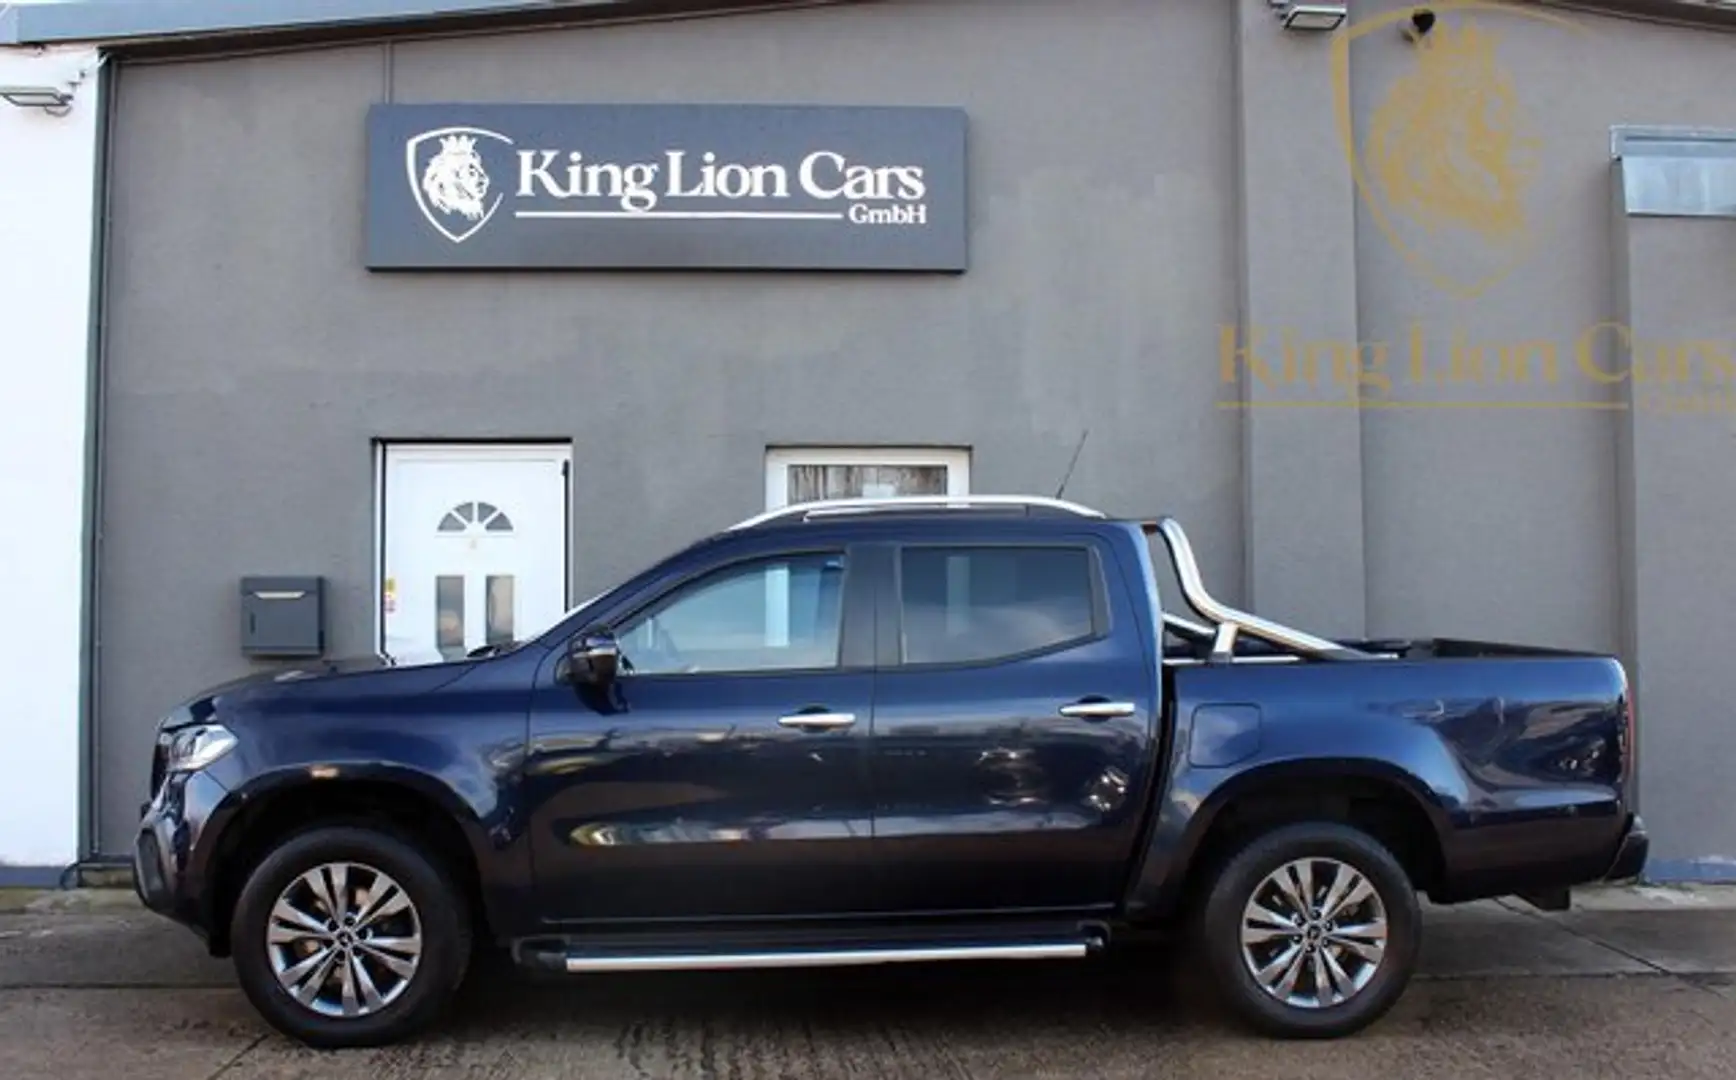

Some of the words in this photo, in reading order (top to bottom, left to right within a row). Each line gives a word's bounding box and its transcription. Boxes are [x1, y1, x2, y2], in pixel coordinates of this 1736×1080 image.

[516, 150, 660, 212] King
[664, 150, 790, 198] Lion
[799, 150, 926, 200] Cars
[848, 203, 927, 224] GmbH
